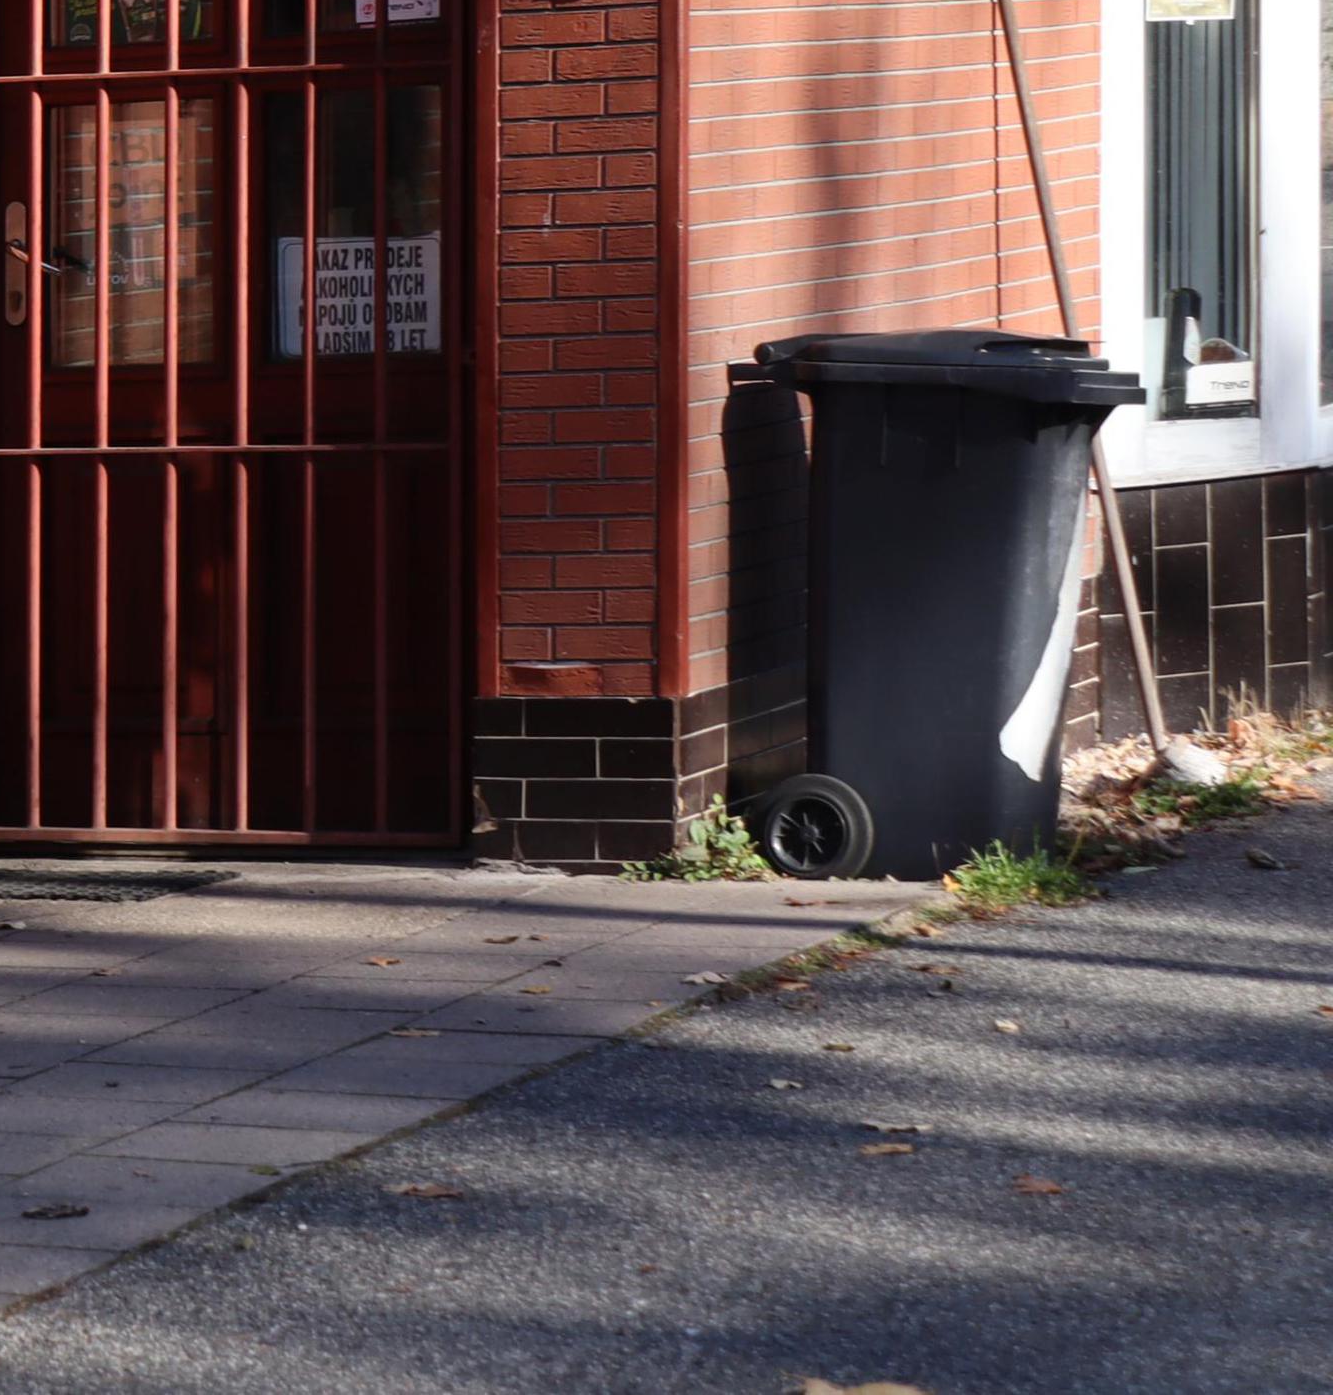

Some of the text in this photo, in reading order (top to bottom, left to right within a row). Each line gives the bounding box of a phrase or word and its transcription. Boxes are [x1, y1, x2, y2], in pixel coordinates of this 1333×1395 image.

[354, 245, 423, 271] PRDEJE
[362, 295, 428, 324] OOBÁM
[401, 329, 427, 351] LET
